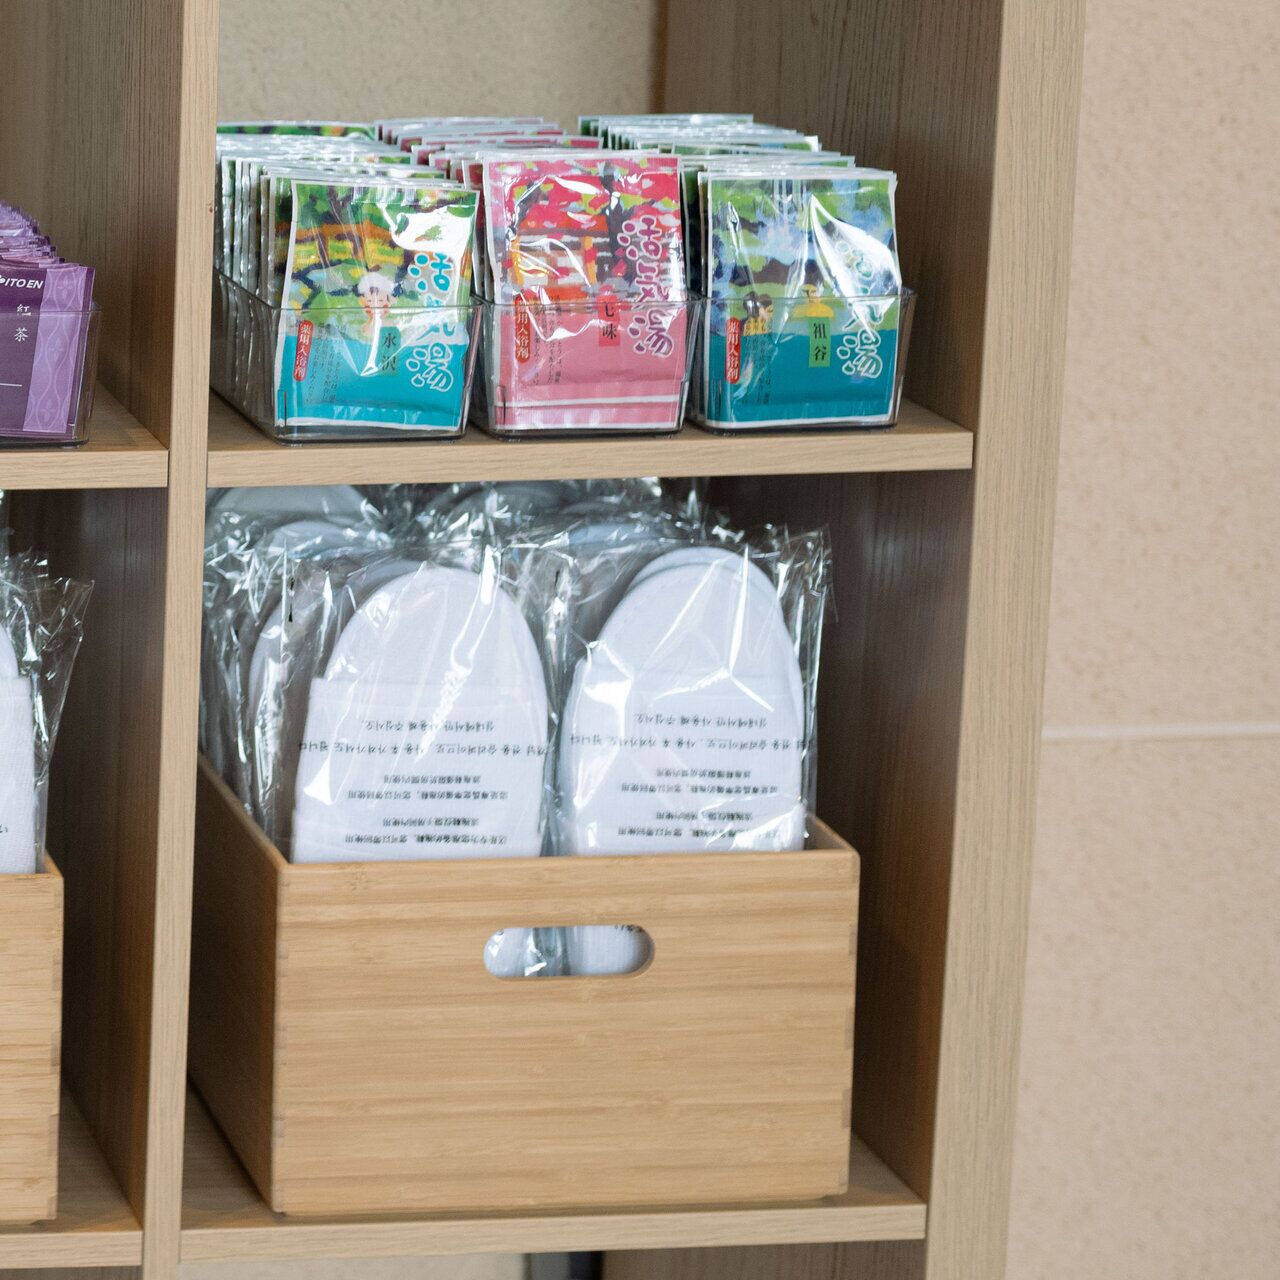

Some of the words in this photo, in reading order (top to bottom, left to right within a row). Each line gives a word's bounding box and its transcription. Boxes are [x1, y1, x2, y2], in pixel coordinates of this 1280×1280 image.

[4, 278, 25, 287] ITO
[26, 279, 43, 289] EN
[14, 303, 32, 342] 紅茶
[602, 302, 618, 340] 七味
[295, 323, 313, 379] 薬用入浴剤
[727, 321, 739, 380] 薬用入浴剤
[812, 323, 828, 361] 祖谷
